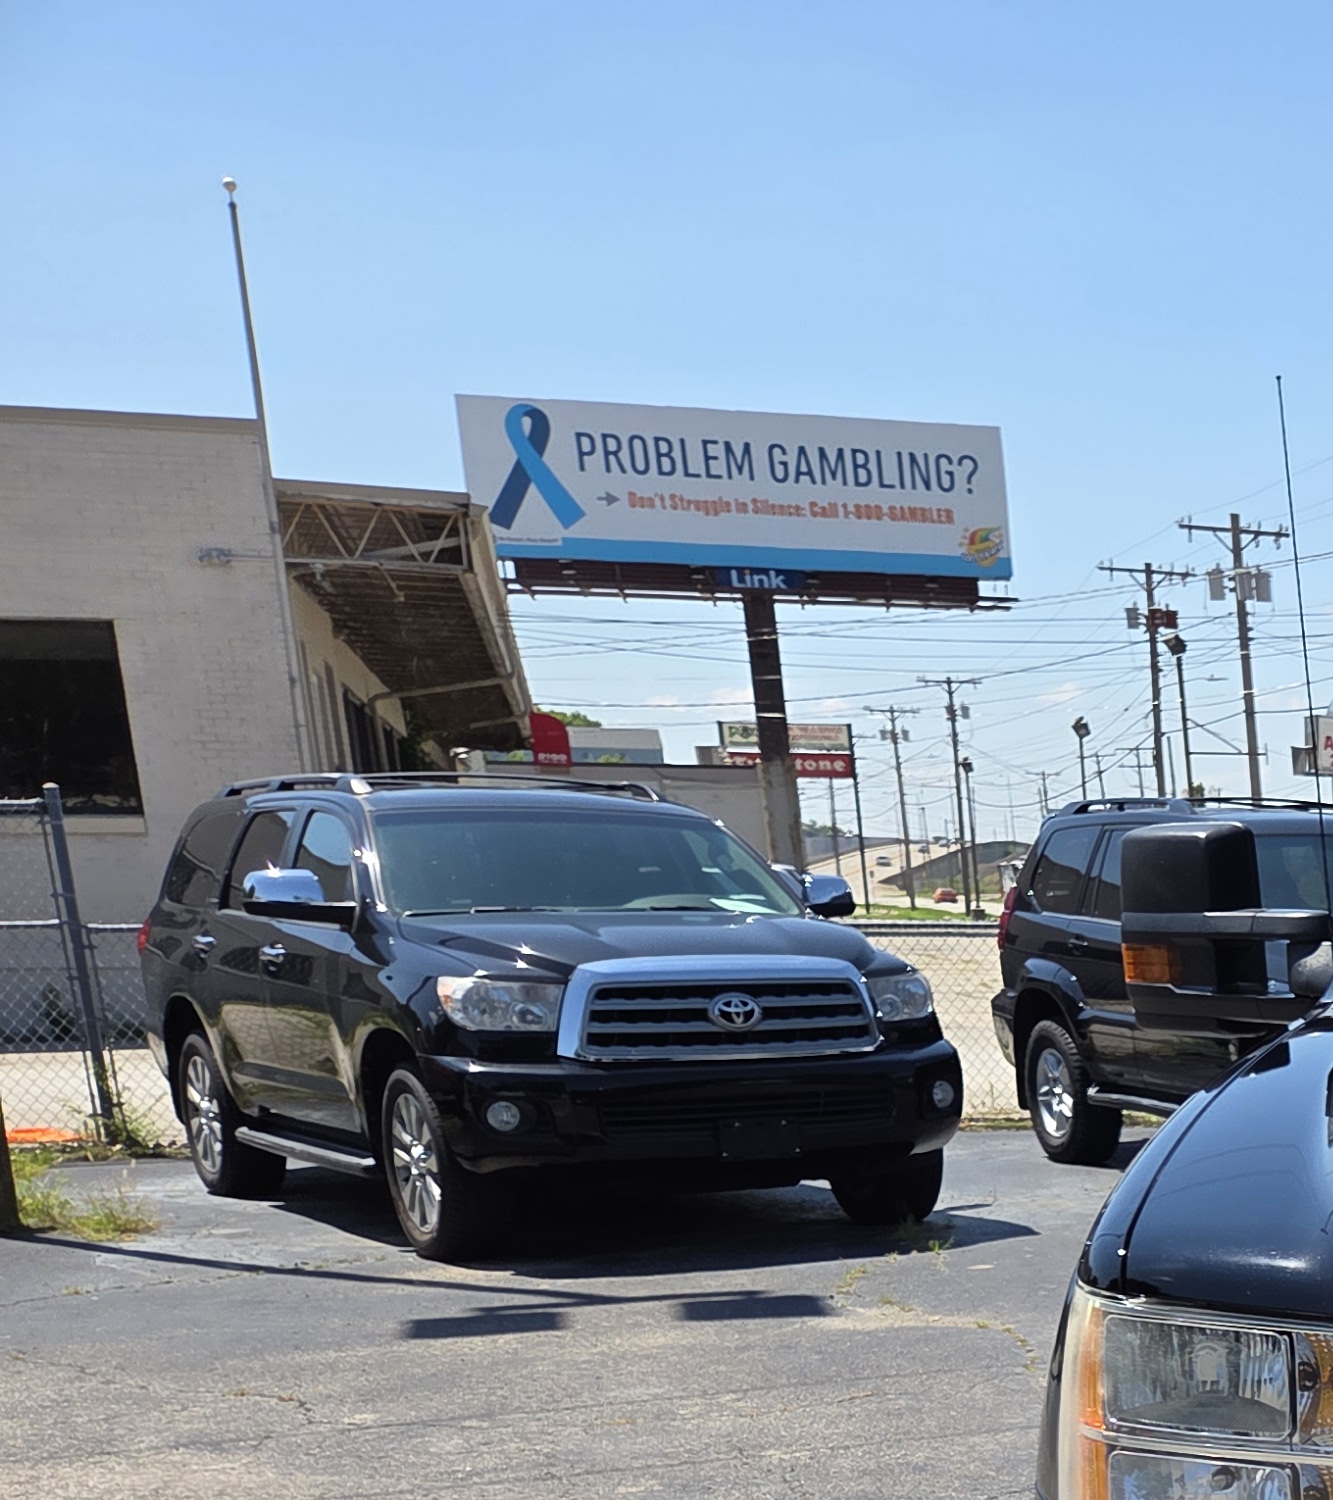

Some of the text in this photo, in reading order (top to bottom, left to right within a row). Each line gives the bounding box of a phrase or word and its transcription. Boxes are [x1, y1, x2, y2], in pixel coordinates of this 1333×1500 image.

[573, 431, 979, 495] PROBLEM GAMBLING?
[627, 490, 667, 511] Don't
[668, 492, 732, 517] Struggle
[808, 501, 840, 519] Call
[730, 569, 788, 590] Link
